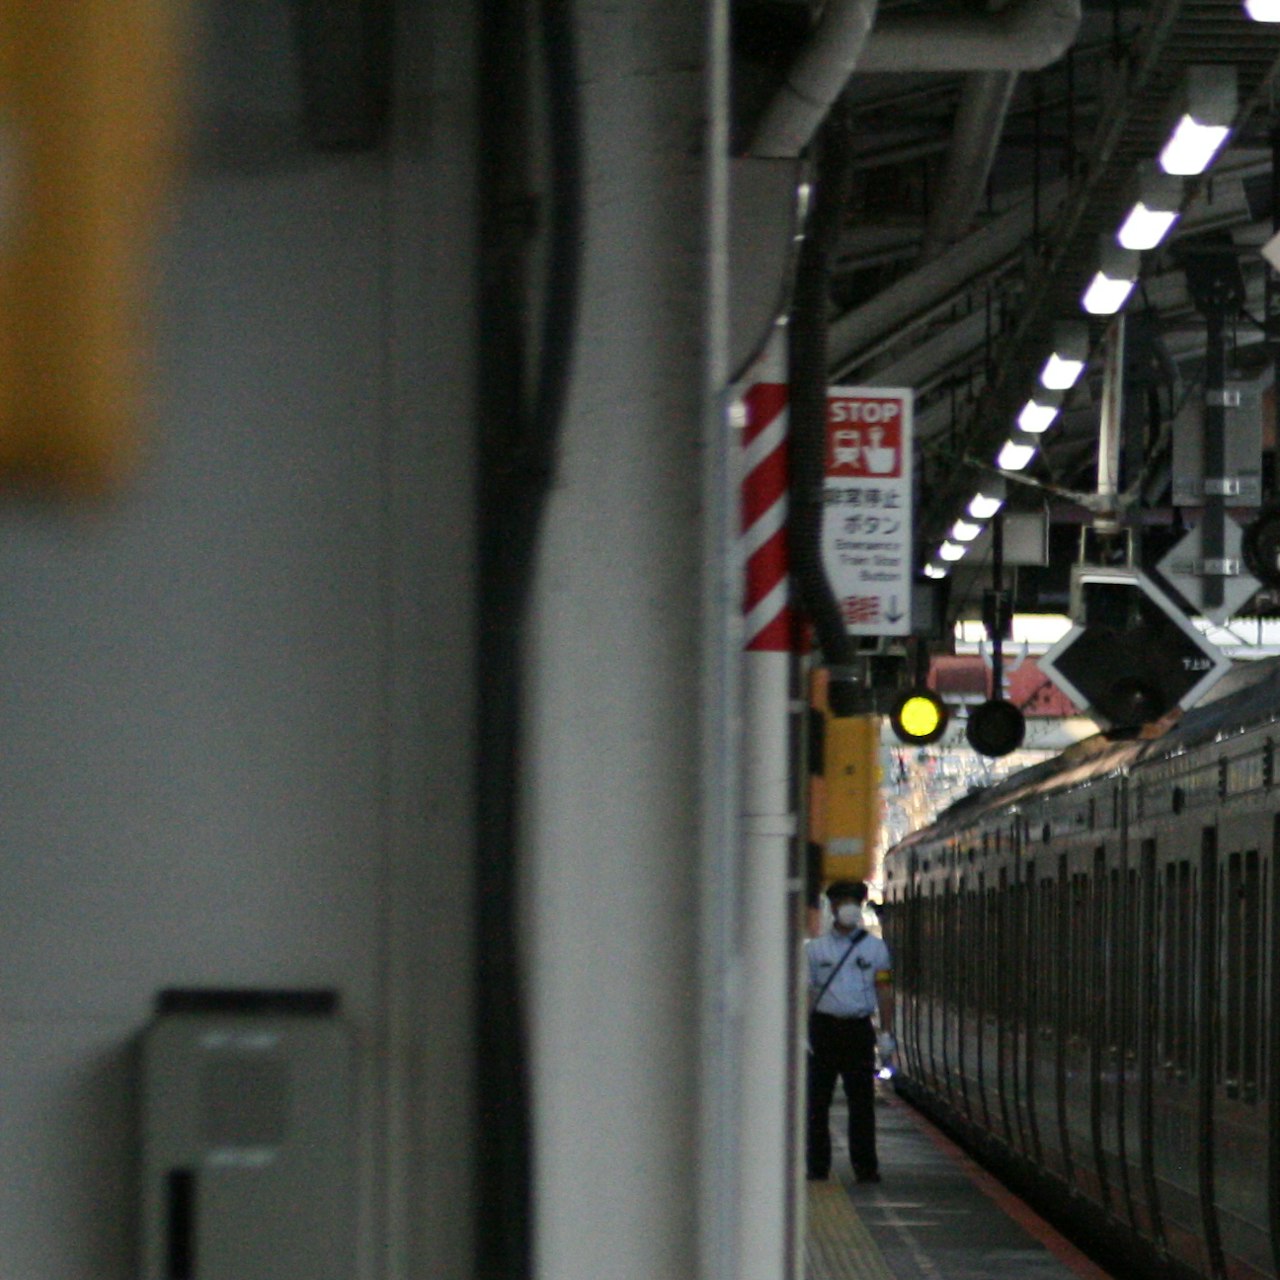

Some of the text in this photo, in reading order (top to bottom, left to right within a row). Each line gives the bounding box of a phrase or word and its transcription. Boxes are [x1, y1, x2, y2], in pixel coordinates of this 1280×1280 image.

[831, 402, 899, 422] STOP
[845, 516, 900, 535] ボタン
